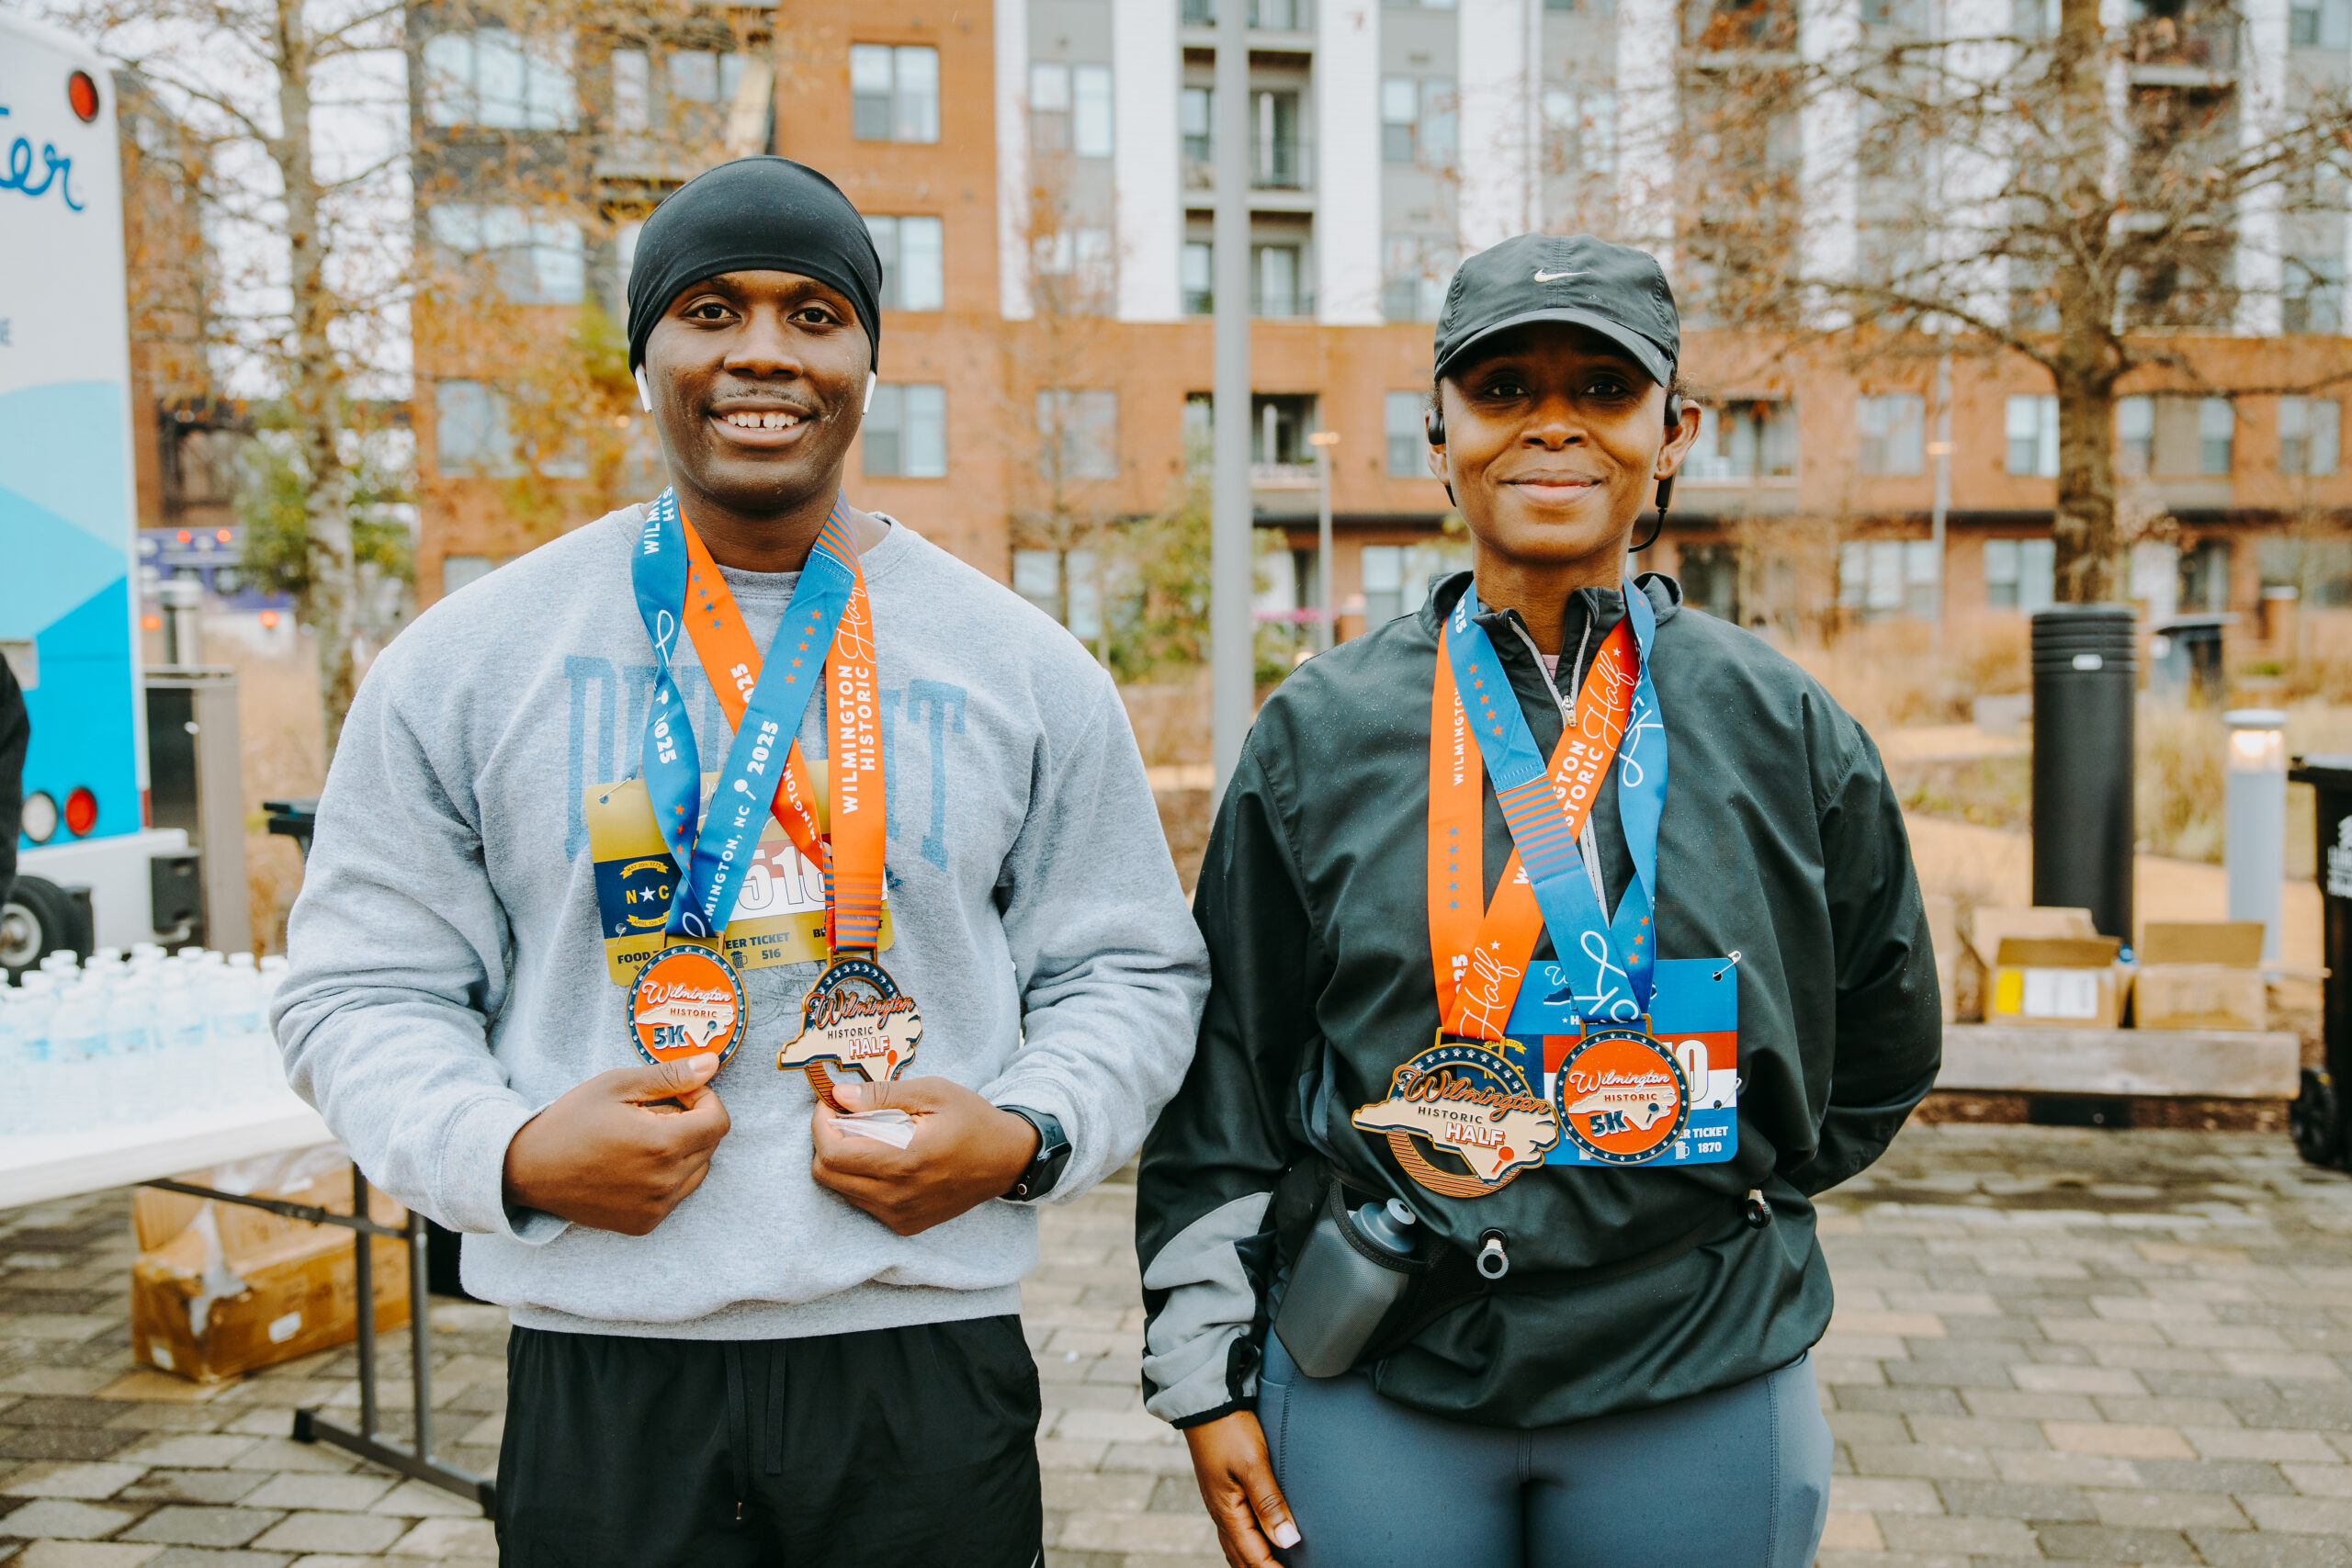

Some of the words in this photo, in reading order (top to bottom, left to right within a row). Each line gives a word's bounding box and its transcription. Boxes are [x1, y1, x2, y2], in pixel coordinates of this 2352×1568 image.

[0, 107, 84, 211] er
[1582, 649, 1635, 751] Half
[855, 666, 876, 771] HISTORIC
[838, 665, 860, 814] WILMINGTON
[704, 834, 743, 922] MINGTON,
[733, 805, 750, 828] NC
[746, 720, 778, 776] 2025
[626, 889, 638, 904] N
[658, 885, 669, 899] C
[717, 938, 747, 951] EER
[750, 931, 790, 946] TICKET
[617, 953, 650, 964] FOOD
[762, 948, 781, 960] 516
[641, 982, 731, 1008] Wilmington
[1459, 947, 1521, 1040] Half
[670, 1009, 717, 1018] HISTORIC
[806, 989, 914, 1030] Wilmington
[653, 1025, 689, 1049] 5K
[827, 1026, 874, 1040] HISTORIC
[849, 1035, 889, 1060] HALF
[1395, 1066, 1549, 1121] Wilmington
[1568, 1070, 1670, 1094] Wilmington
[1604, 1093, 1657, 1102] HISTORIC
[1419, 1106, 1484, 1124] HISTORIC
[1589, 1110, 1631, 1137] 5K
[1445, 1122, 1506, 1148] HALF
[1692, 1126, 1728, 1138] TICKET
[1698, 1142, 1722, 1154] 1870
